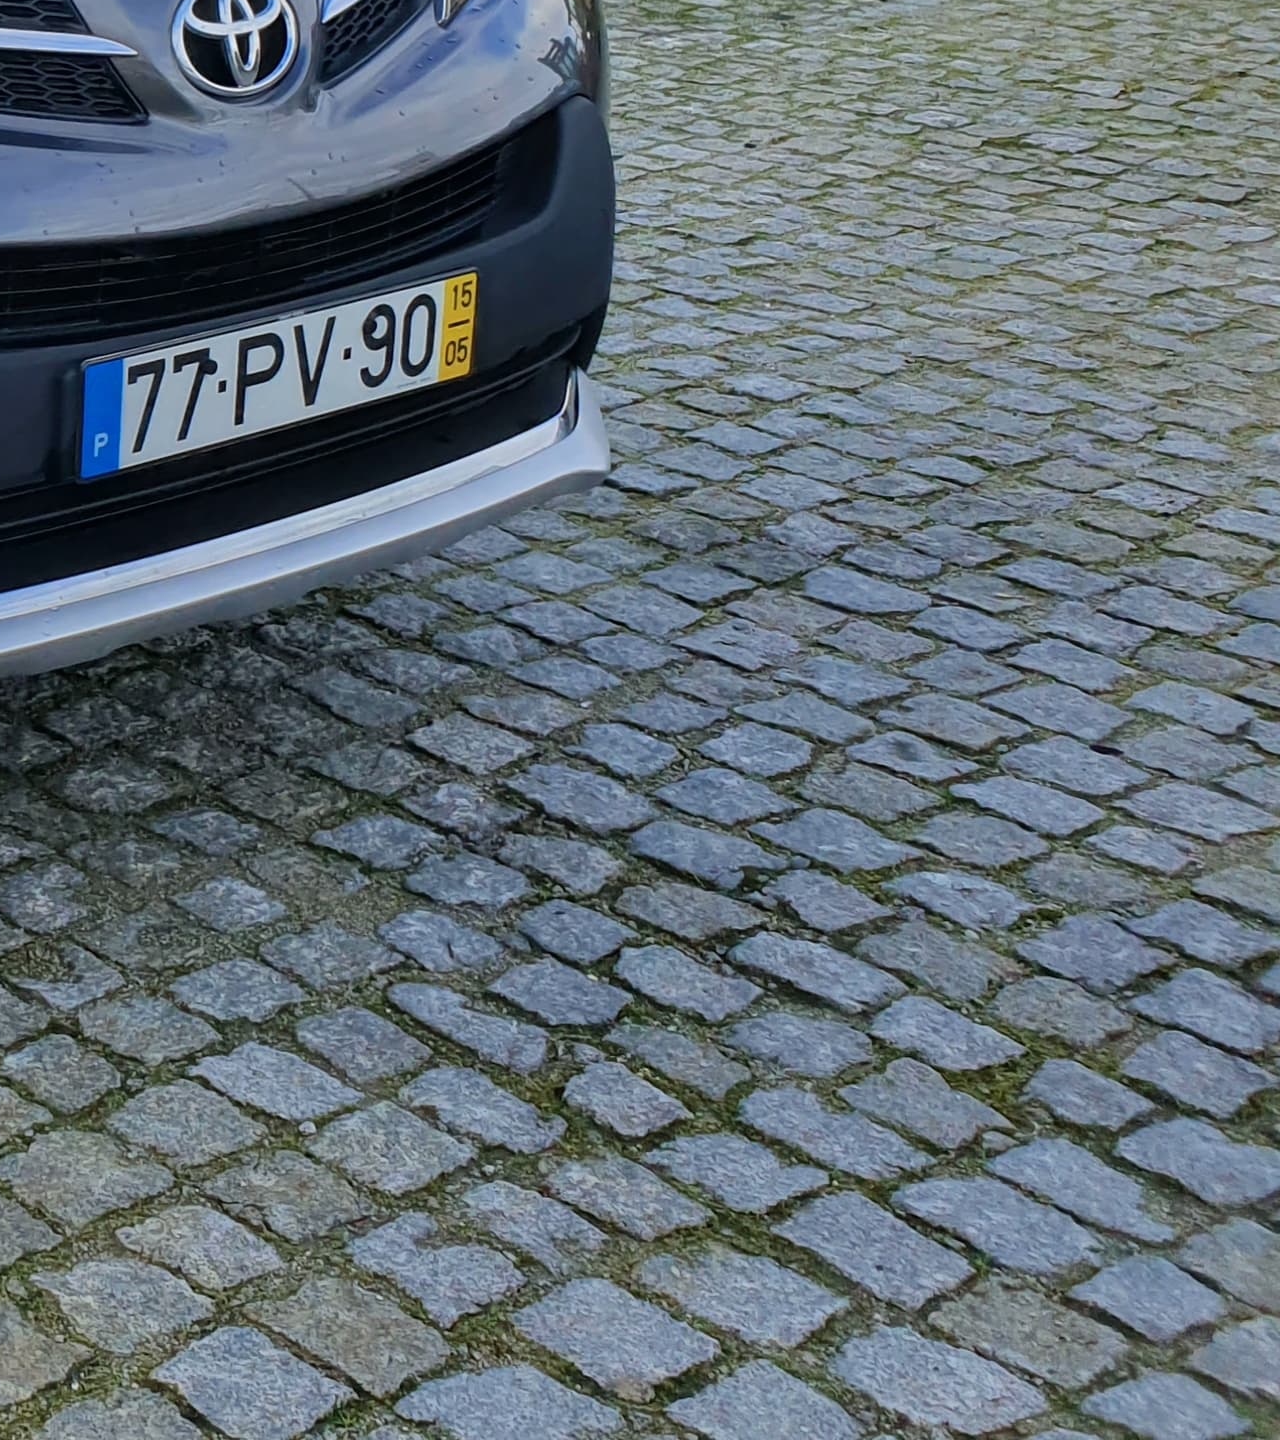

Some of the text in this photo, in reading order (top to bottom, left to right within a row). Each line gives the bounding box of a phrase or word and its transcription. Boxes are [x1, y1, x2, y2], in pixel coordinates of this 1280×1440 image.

[451, 279, 474, 312] 15
[443, 335, 469, 368] 05
[92, 431, 110, 458] P
